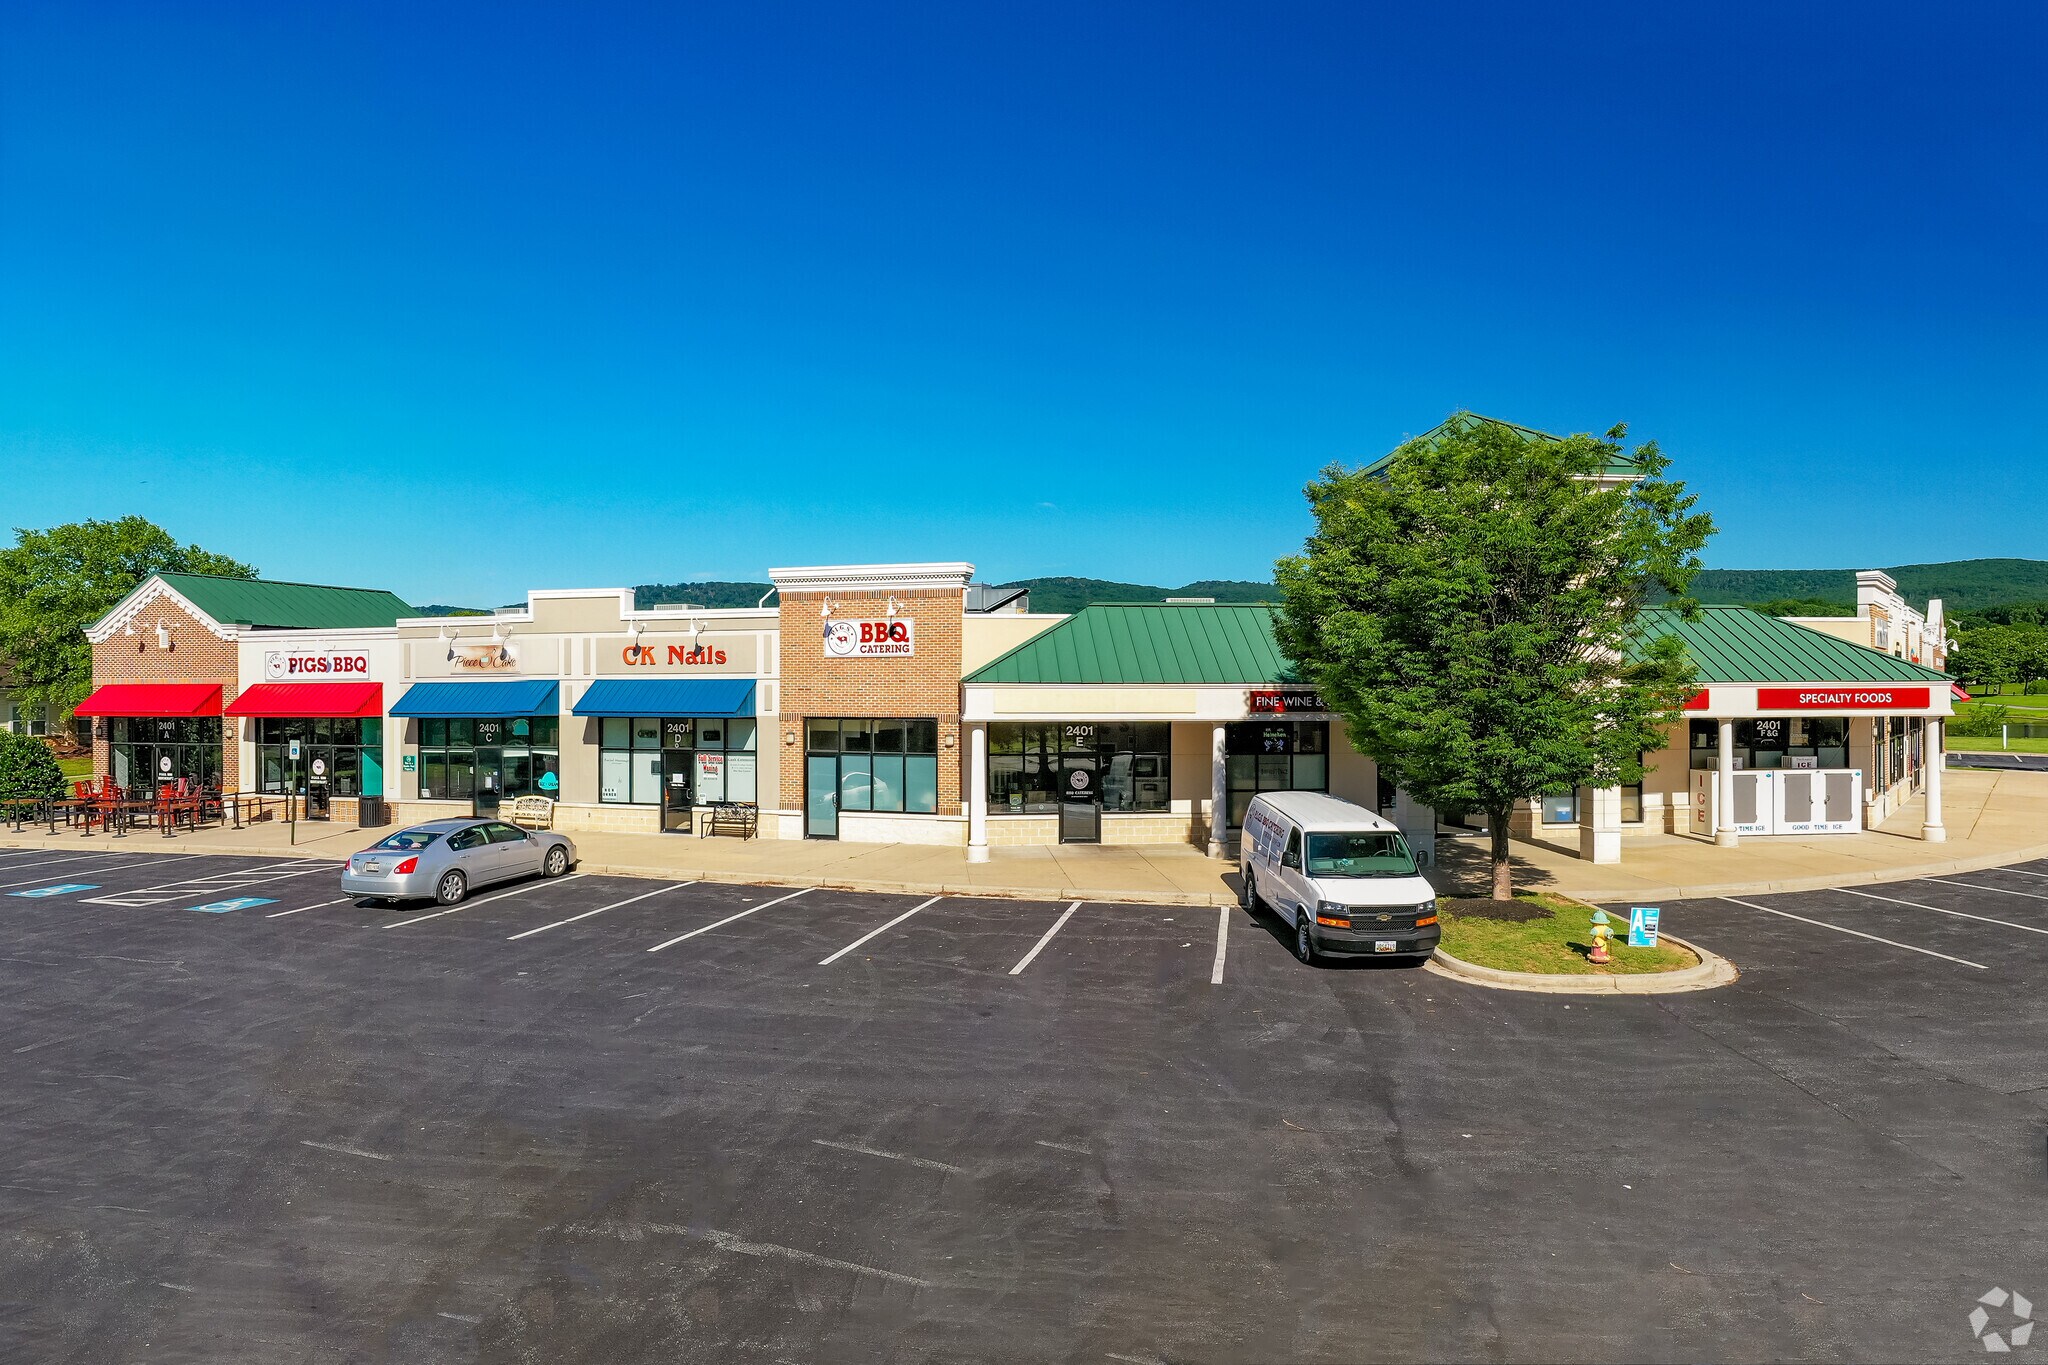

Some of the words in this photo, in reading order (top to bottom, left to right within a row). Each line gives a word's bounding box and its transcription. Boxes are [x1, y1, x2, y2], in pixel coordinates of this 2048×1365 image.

[860, 622, 909, 643] BBQ
[622, 645, 656, 665] CK
[667, 645, 727, 665] Nails
[860, 645, 910, 654] CATERING
[288, 657, 327, 673] PIGS
[333, 656, 367, 673] BBQ
[453, 655, 478, 668] Piece
[1256, 696, 1280, 707] FINE
[1282, 696, 1313, 707] WINE
[1799, 693, 1852, 704] SPECIALTY
[1854, 693, 1892, 703] FOODS
[158, 721, 175, 730] 2401
[479, 723, 499, 733] 2401
[667, 723, 690, 733] 2401
[1065, 725, 1094, 736] 2401
[1756, 720, 1781, 730] 2401
[163, 730, 170, 739] A
[485, 732, 493, 743] C
[674, 733, 682, 743] D
[1075, 736, 1084, 747] E
